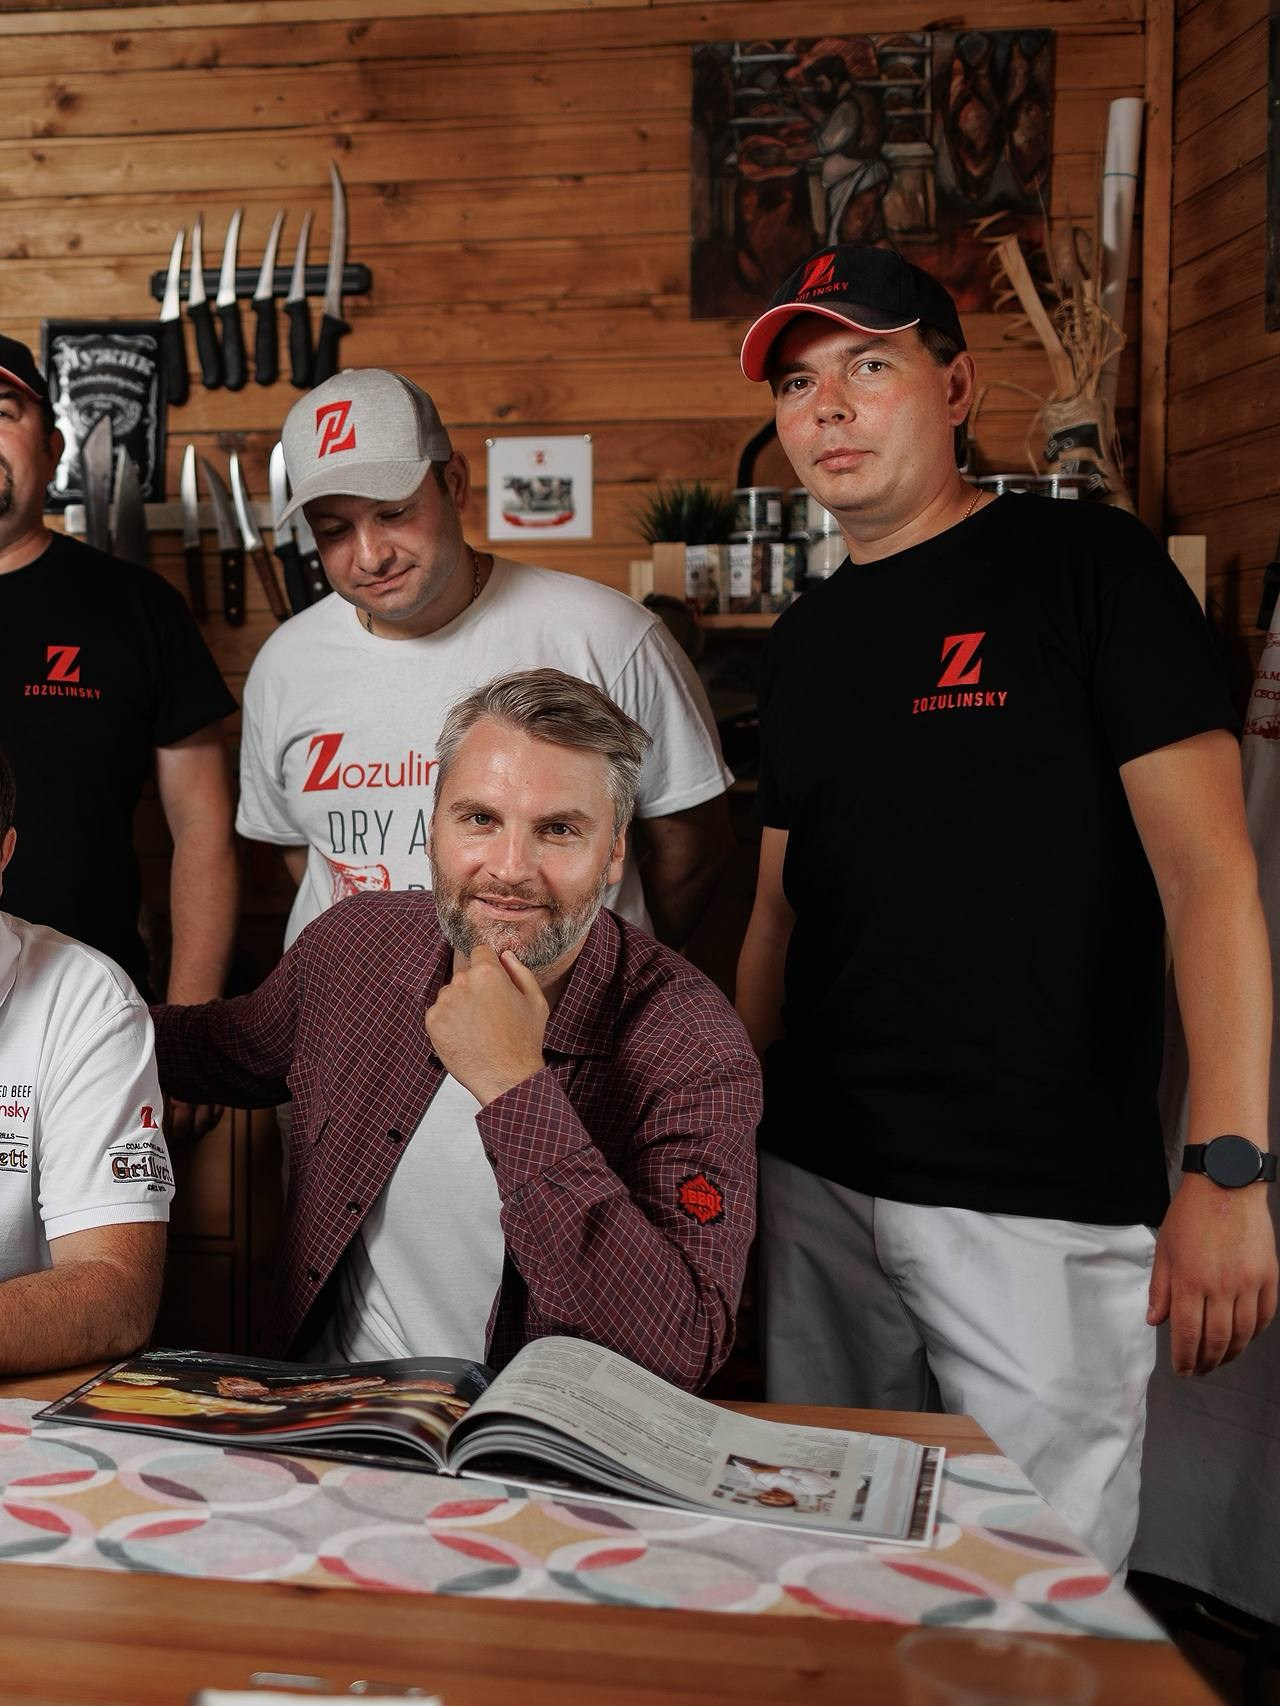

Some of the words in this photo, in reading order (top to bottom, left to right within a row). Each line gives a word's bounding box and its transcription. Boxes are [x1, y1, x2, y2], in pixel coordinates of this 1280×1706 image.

[47, 645, 81, 683] Z
[937, 632, 986, 687] Z
[24, 684, 101, 700] ZOZULINSKY
[912, 691, 1008, 714] ZOZULINSKY
[302, 732, 439, 793] Zozulin
[328, 808, 394, 856] DRY
[408, 807, 429, 856] A
[11, 1085, 33, 1098] BEEF
[140, 1106, 159, 1129] Z
